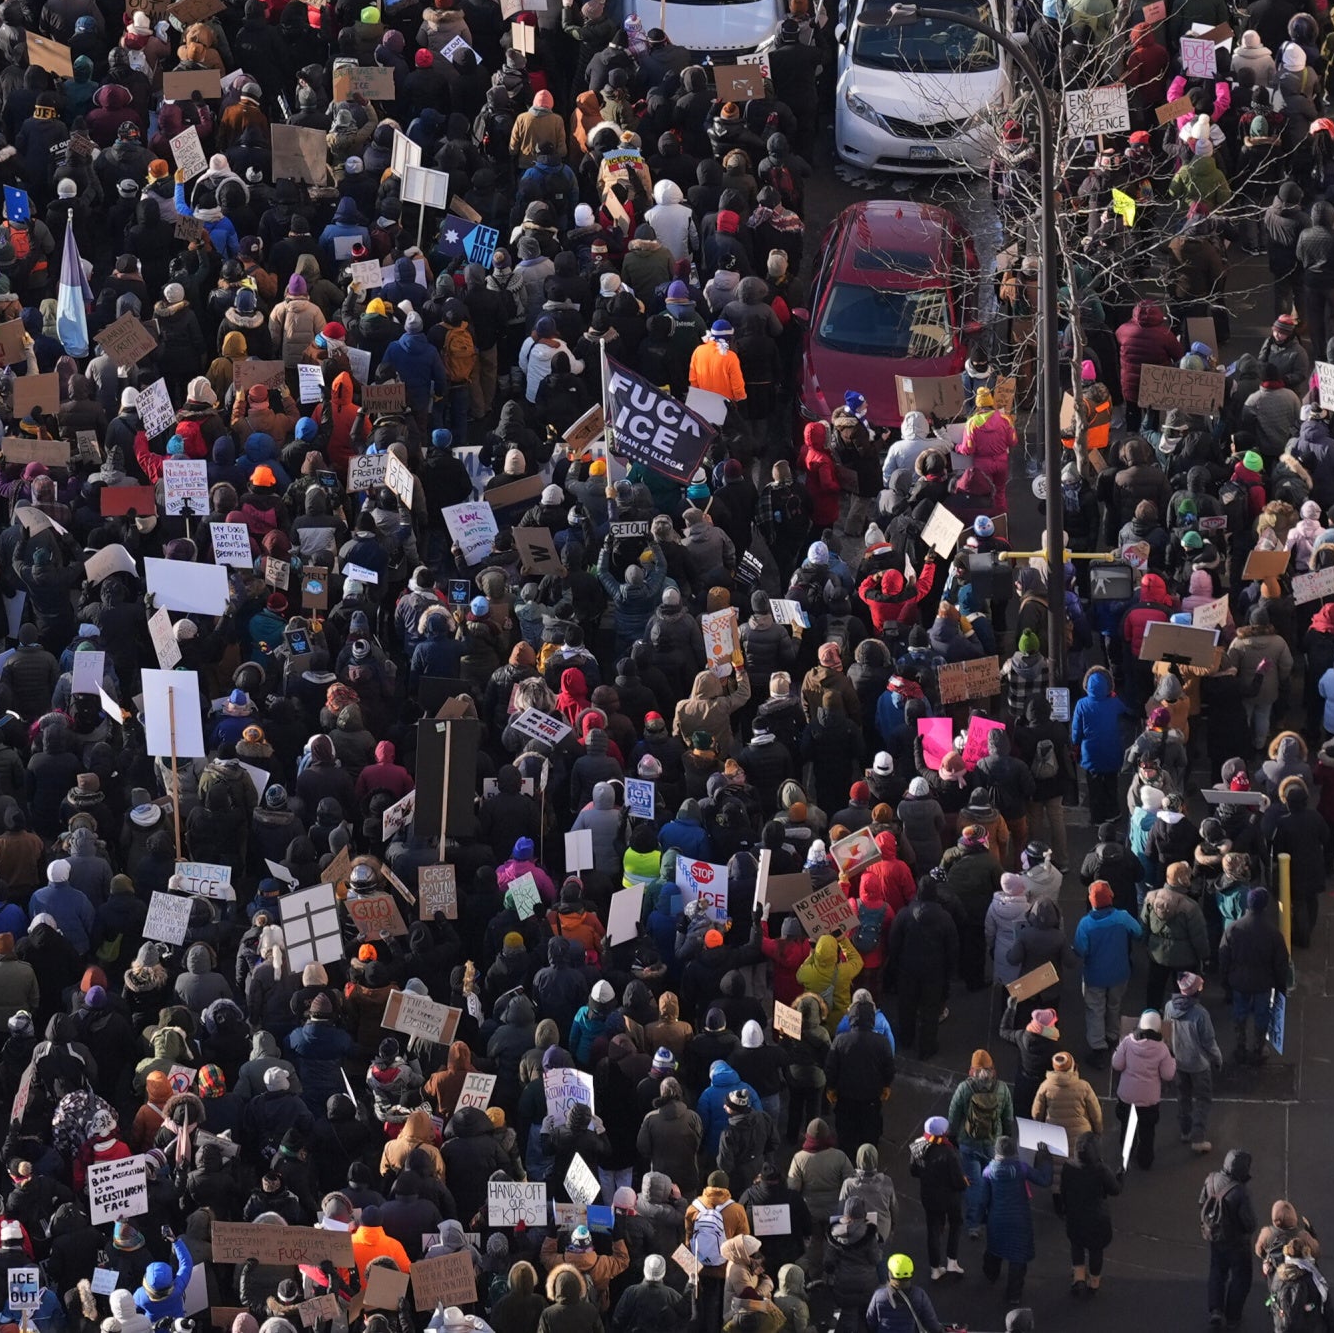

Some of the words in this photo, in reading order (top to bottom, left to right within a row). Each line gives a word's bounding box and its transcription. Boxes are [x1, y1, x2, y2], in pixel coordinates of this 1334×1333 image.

[475, 224, 498, 246] ICE
[470, 245, 492, 269] OUT
[1153, 384, 1199, 396] INCEL
[616, 406, 674, 455] ICE
[612, 430, 639, 452] UMAN
[640, 444, 650, 455] IS
[650, 449, 684, 471] ILLEGAL
[357, 456, 384, 469] GET
[459, 512, 482, 525] LOVE
[269, 557, 287, 572] ICE
[178, 863, 228, 882] ABOLISH
[424, 868, 451, 881] GREG
[692, 867, 713, 880] STOP
[187, 878, 219, 896] ICE
[796, 901, 809, 912] NO
[810, 888, 832, 905] ONE
[469, 1076, 492, 1092] ICE
[462, 1093, 486, 1108] OUT
[92, 1175, 111, 1186] BAD
[112, 1167, 145, 1181] MIGRATION
[94, 1192, 122, 1205] KRISTI
[489, 1185, 521, 1199] HANDS
[524, 1184, 545, 1199] OFF
[105, 1200, 129, 1213] FACE
[508, 1199, 526, 1208] OUR
[502, 1207, 537, 1225] KIDS
[278, 1248, 313, 1262] FUCK
[13, 1273, 34, 1284] ICE
[11, 1292, 38, 1303] OUT
